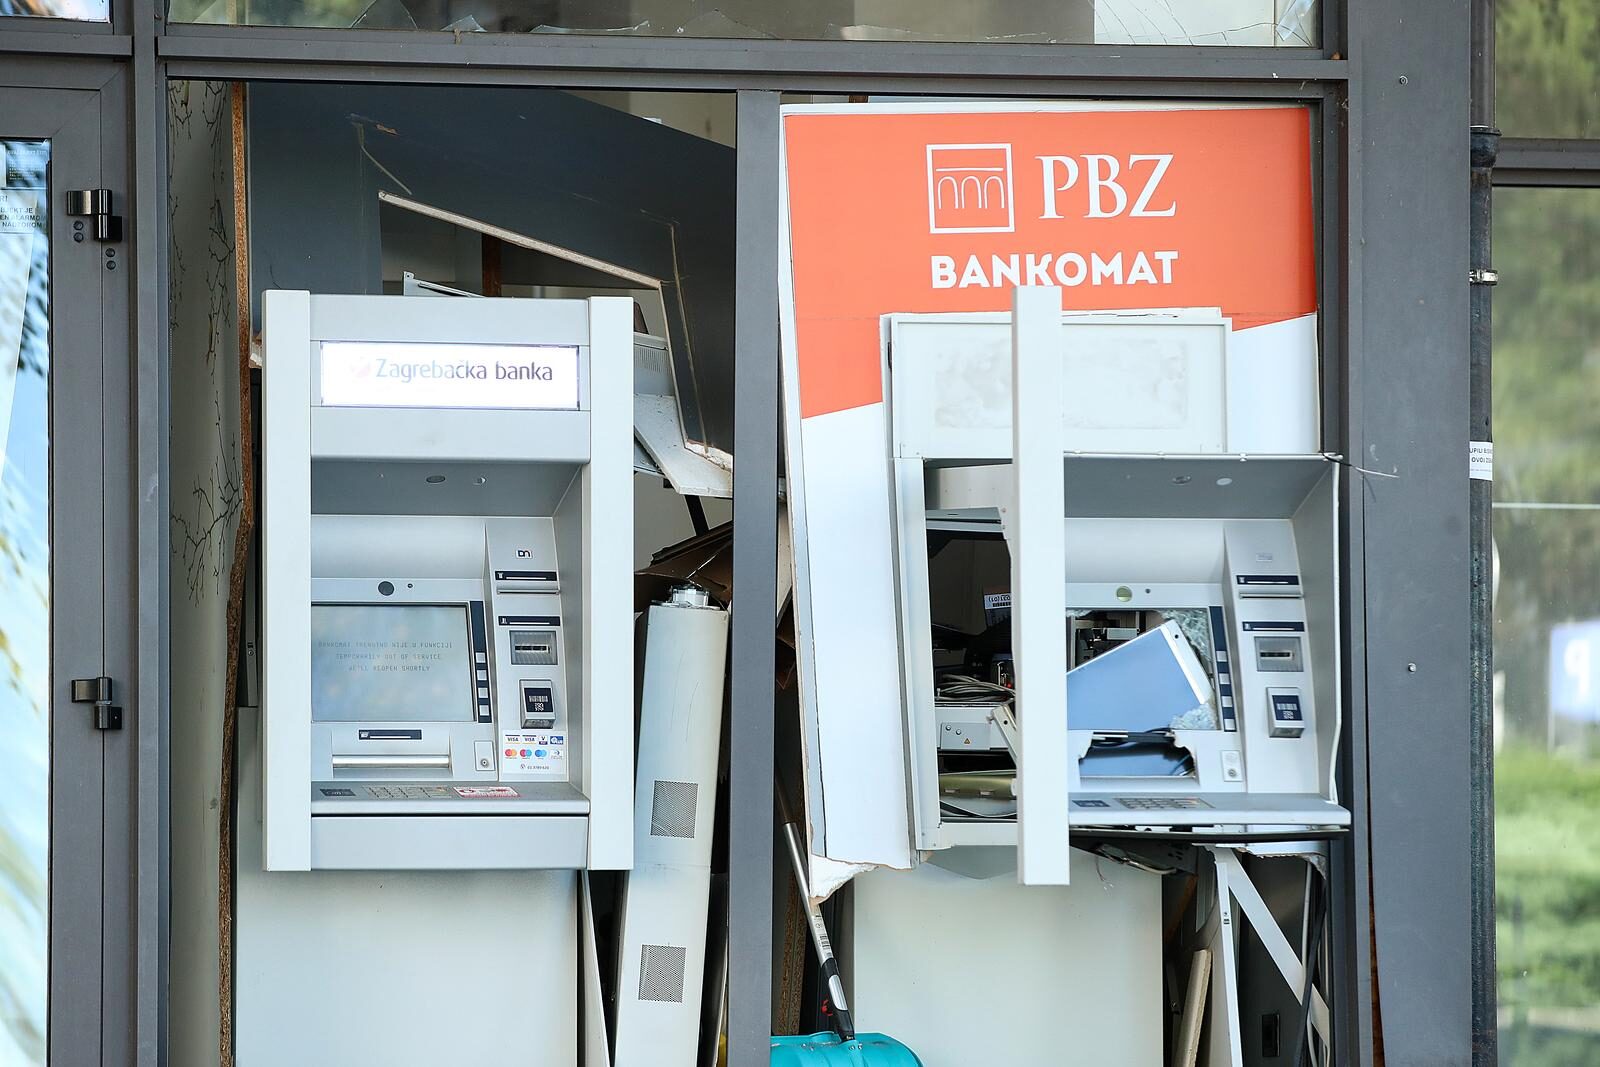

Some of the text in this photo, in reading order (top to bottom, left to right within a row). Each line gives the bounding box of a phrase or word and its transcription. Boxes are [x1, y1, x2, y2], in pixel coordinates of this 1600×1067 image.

[1034, 154, 1177, 219] PBZ
[930, 250, 1179, 289] BANKOMAT
[376, 358, 553, 383] Zagrebačka banka
[392, 641, 408, 649] NIJE
[420, 641, 453, 649] FUNKCIJI
